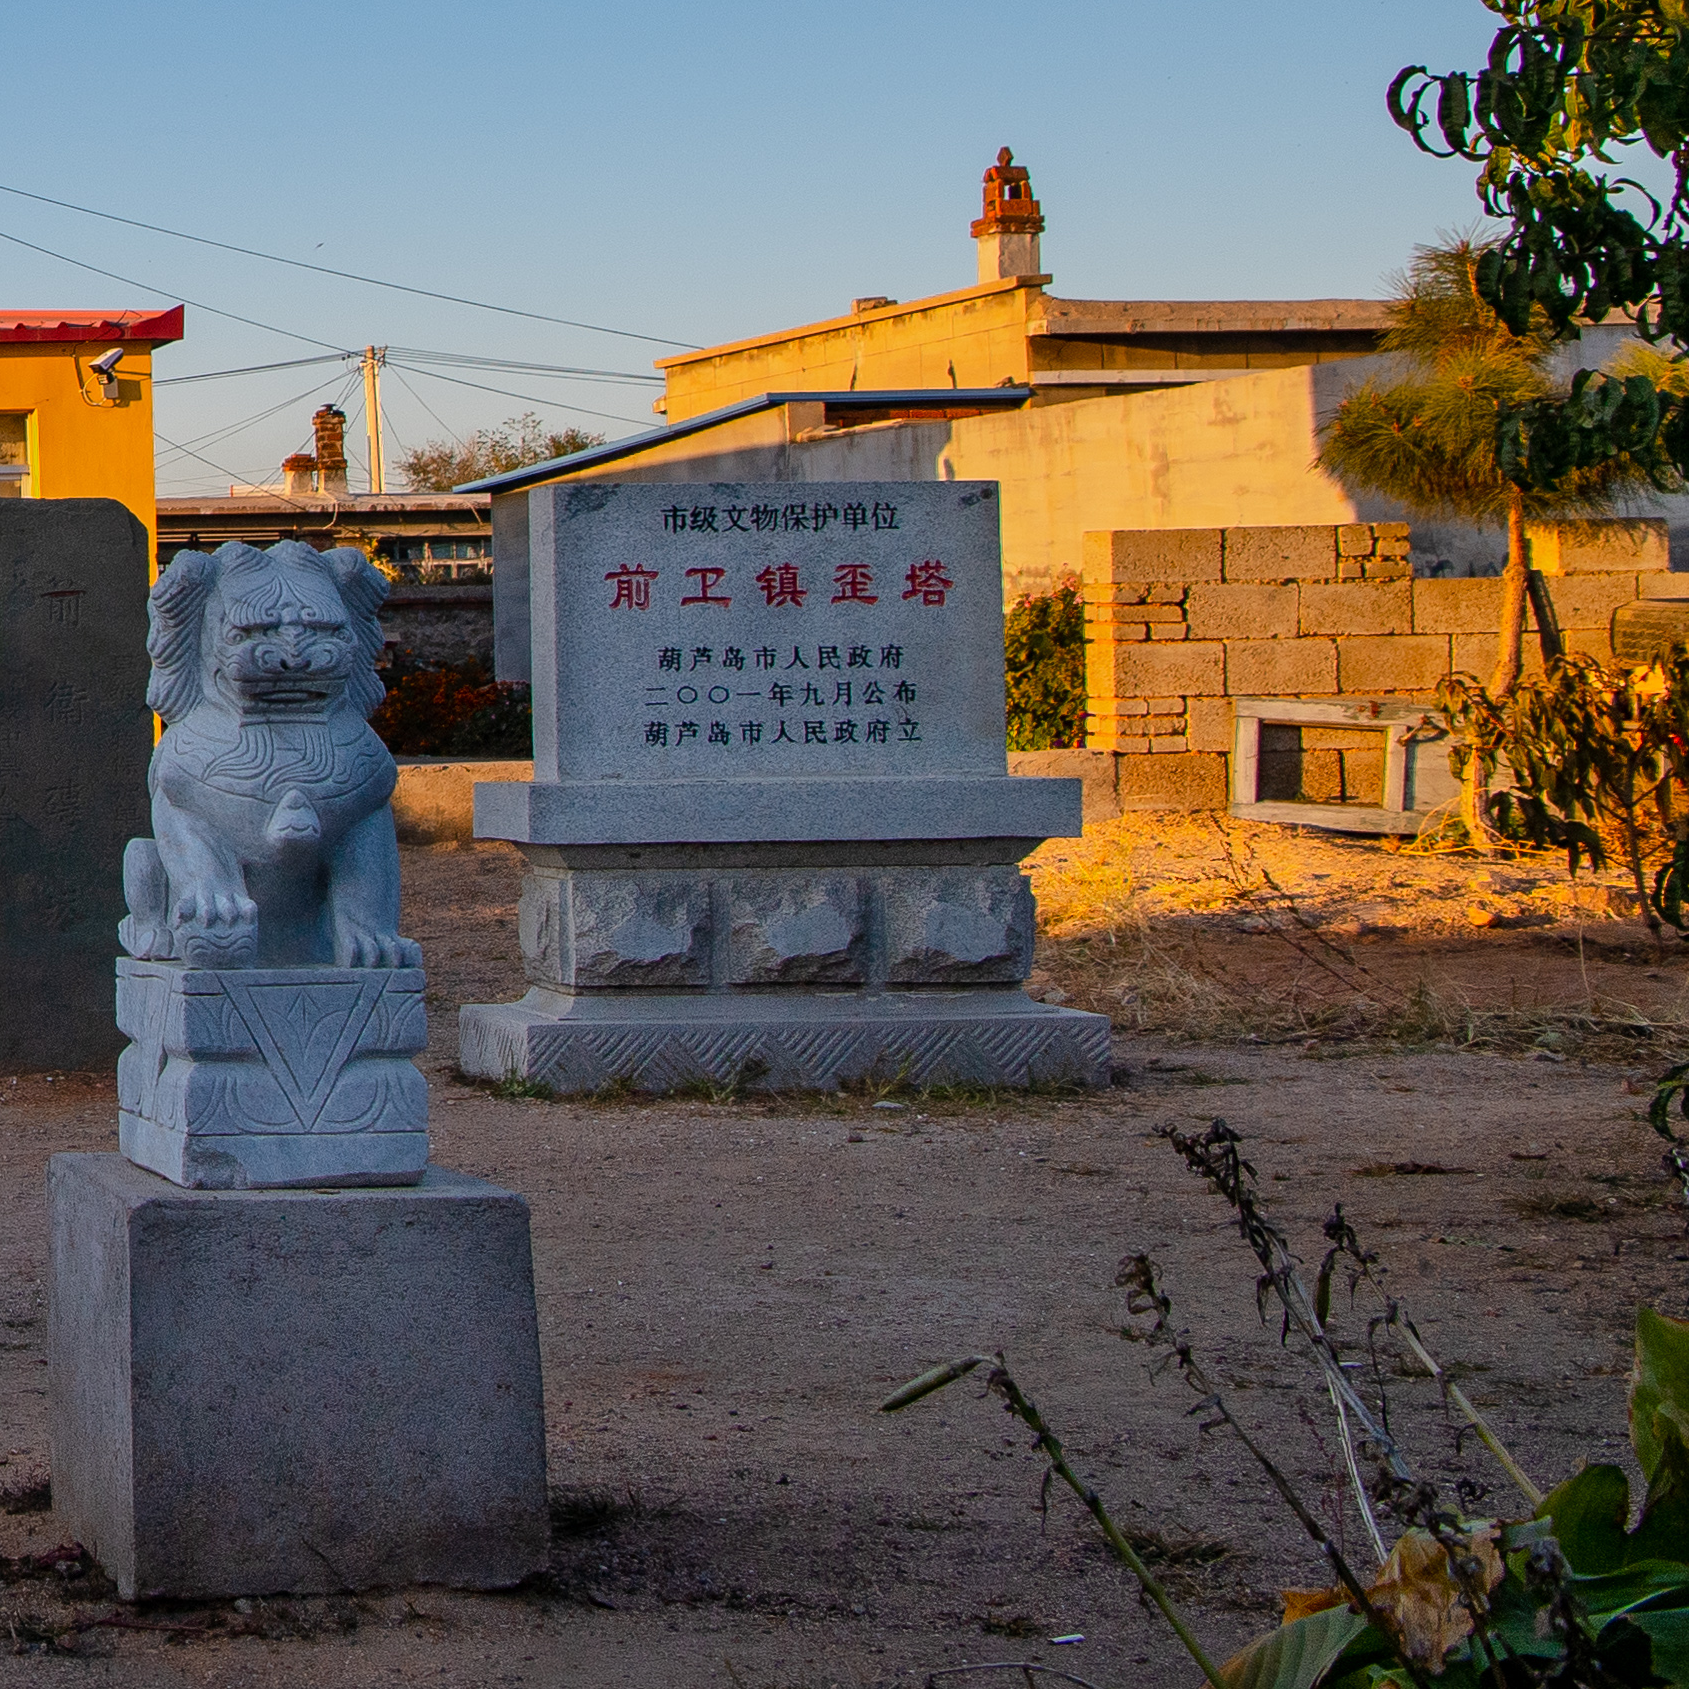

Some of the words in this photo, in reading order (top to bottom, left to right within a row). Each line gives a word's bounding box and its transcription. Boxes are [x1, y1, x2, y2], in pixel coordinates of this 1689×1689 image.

[662, 504, 900, 534] 市级文物保护单位
[604, 561, 954, 612] 前卫镇歪塔
[658, 645, 904, 672] 葫芦岛市人民政府
[644, 718, 922, 746] 葫芦岛市人民政府立
